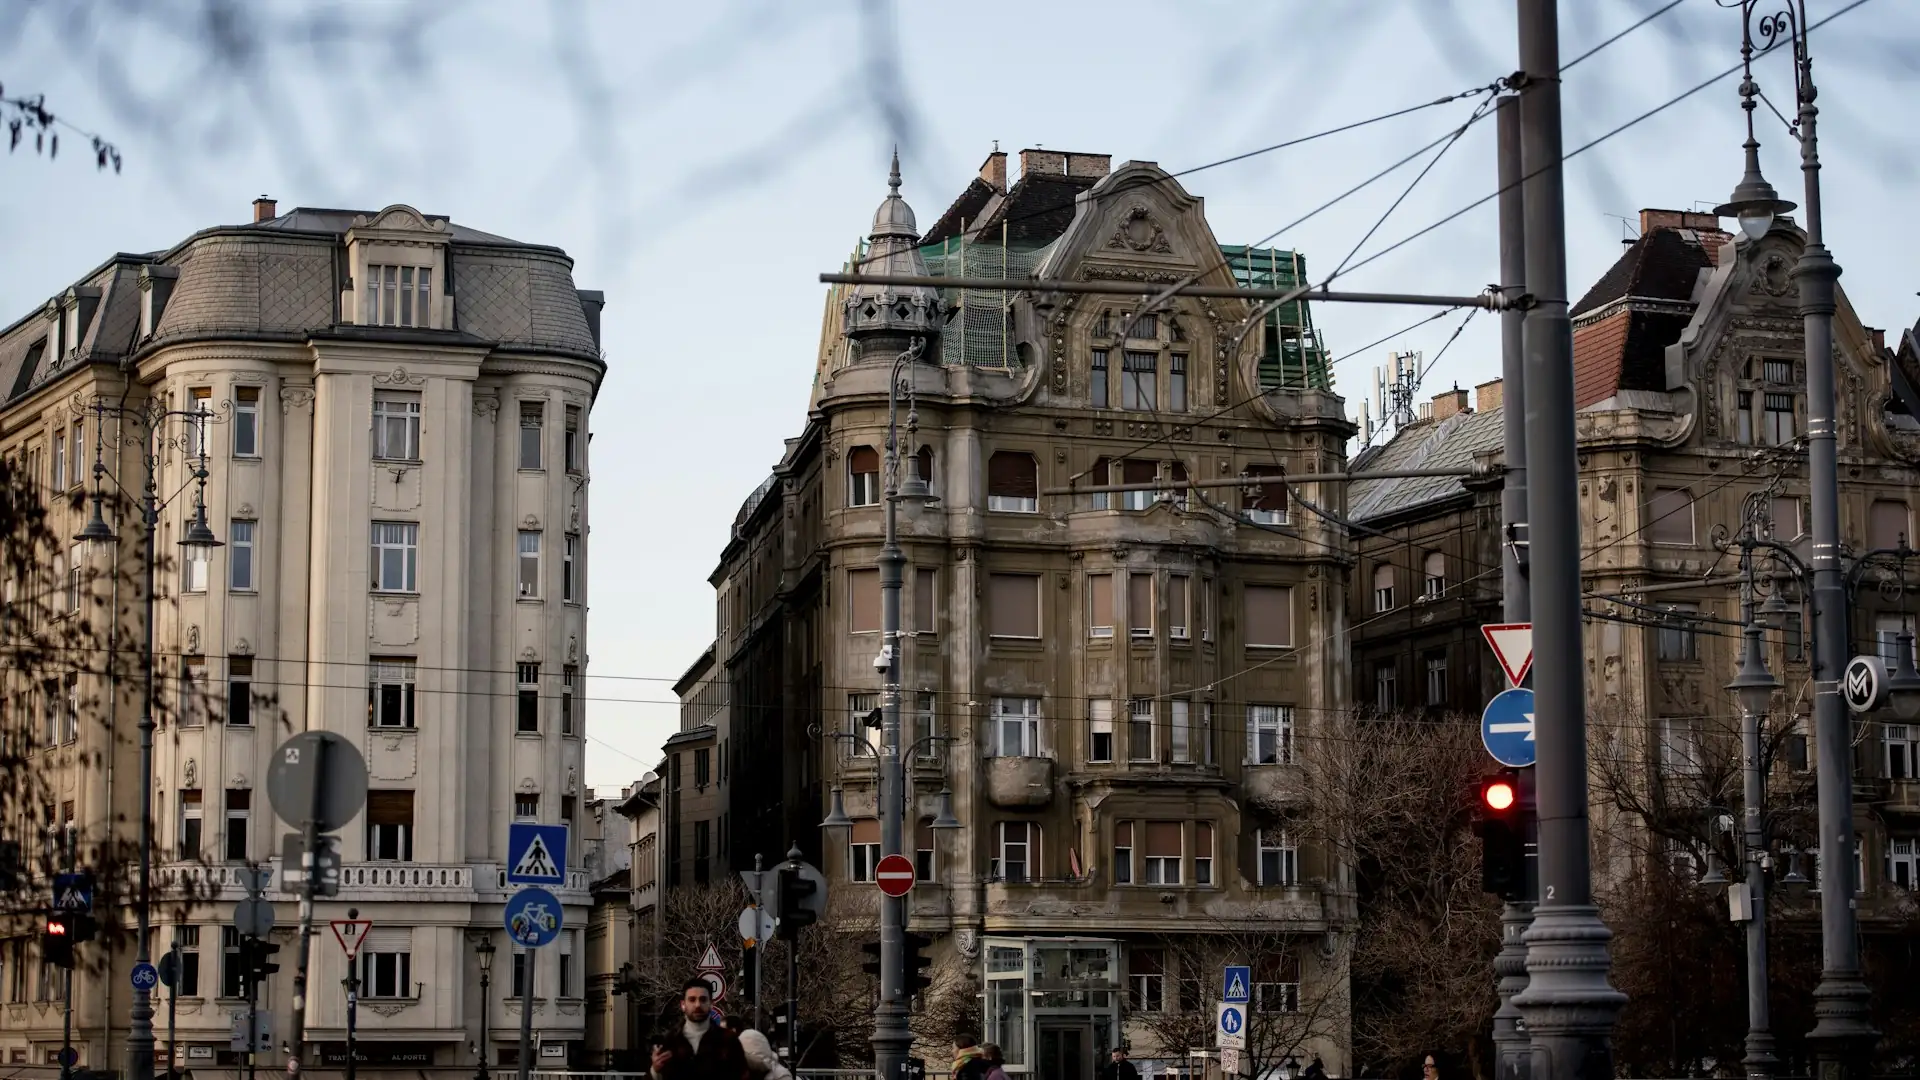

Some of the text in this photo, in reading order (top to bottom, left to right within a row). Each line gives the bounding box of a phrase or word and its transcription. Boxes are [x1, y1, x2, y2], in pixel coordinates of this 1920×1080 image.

[1848, 668, 1869, 699] M
[1546, 886, 1555, 900] 2
[1509, 926, 1515, 937] 1
